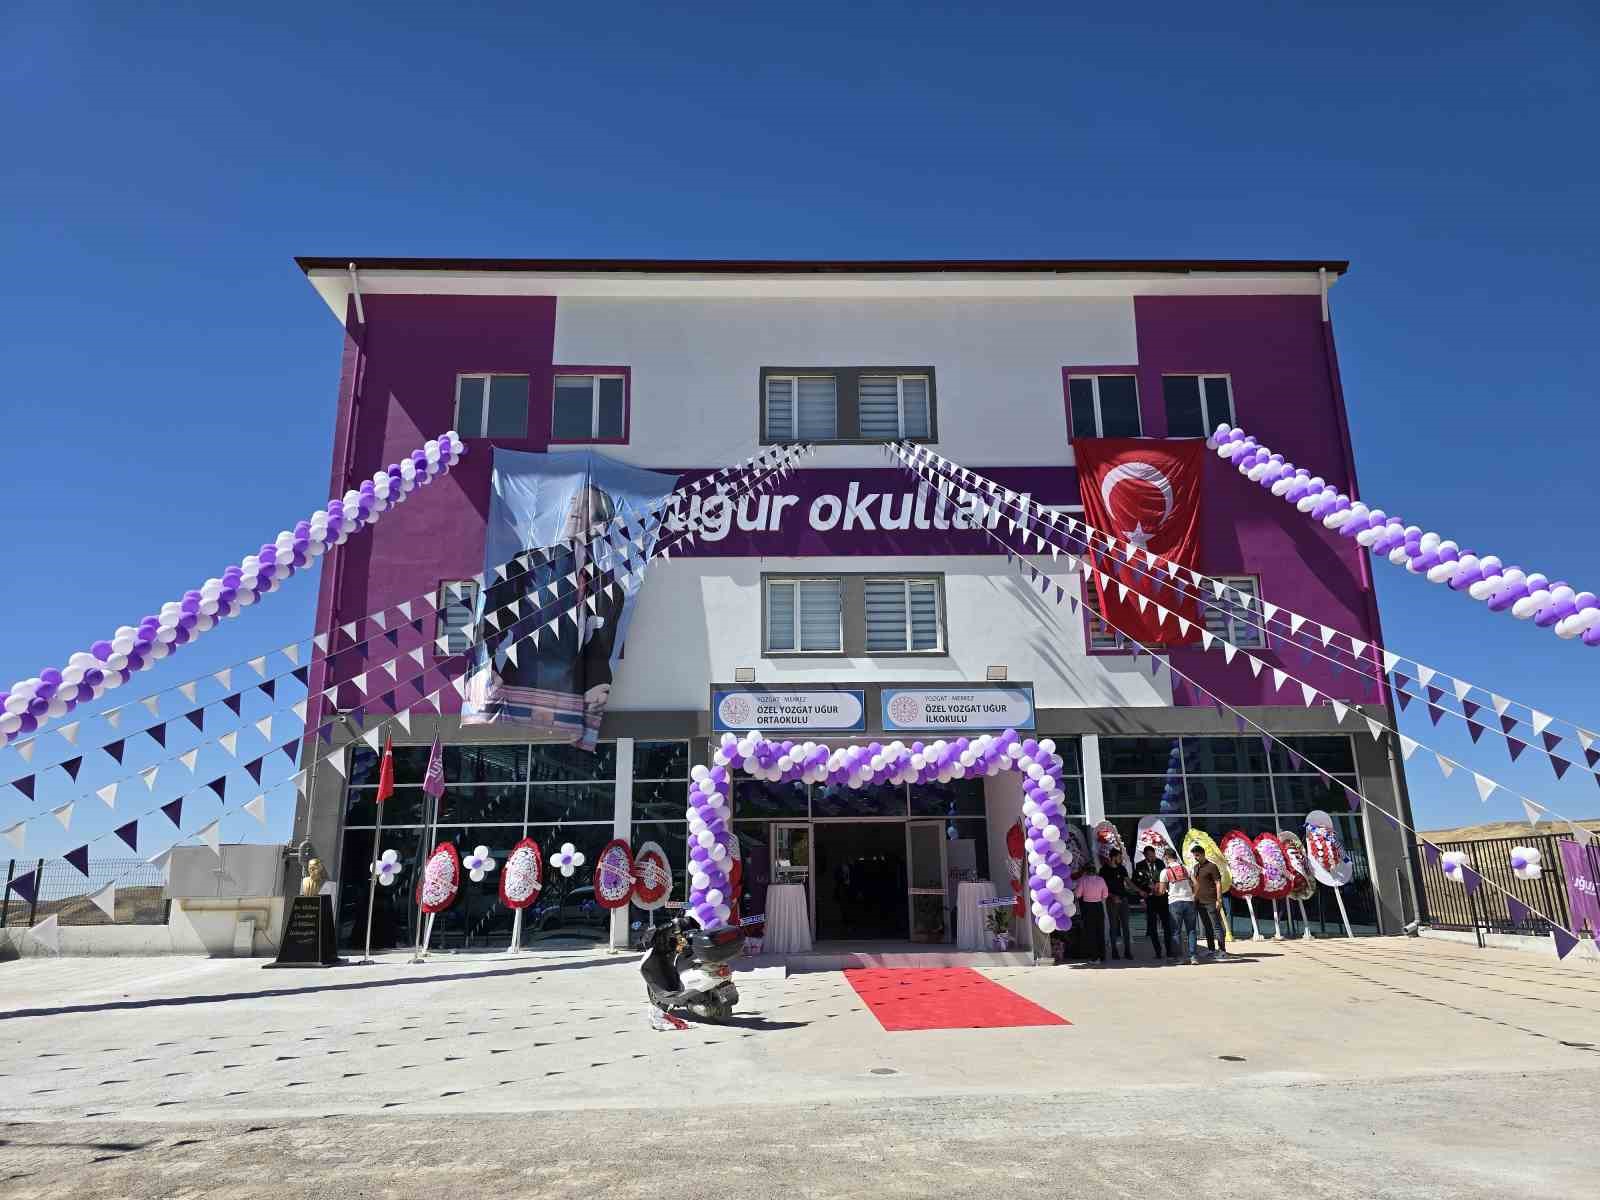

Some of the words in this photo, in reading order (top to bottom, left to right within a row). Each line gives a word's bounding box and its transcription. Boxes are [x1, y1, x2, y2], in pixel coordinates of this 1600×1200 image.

[757, 704, 778, 714] ÖZEL
[779, 705, 812, 714] YOZGAT
[814, 704, 839, 714] UĞUR
[925, 703, 946, 713] ÖZEL
[948, 704, 981, 713] YOZGAT
[982, 703, 1008, 713] UĞUR
[756, 716, 808, 724] ORTAOKULU
[925, 713, 968, 723] İLKOKULU
